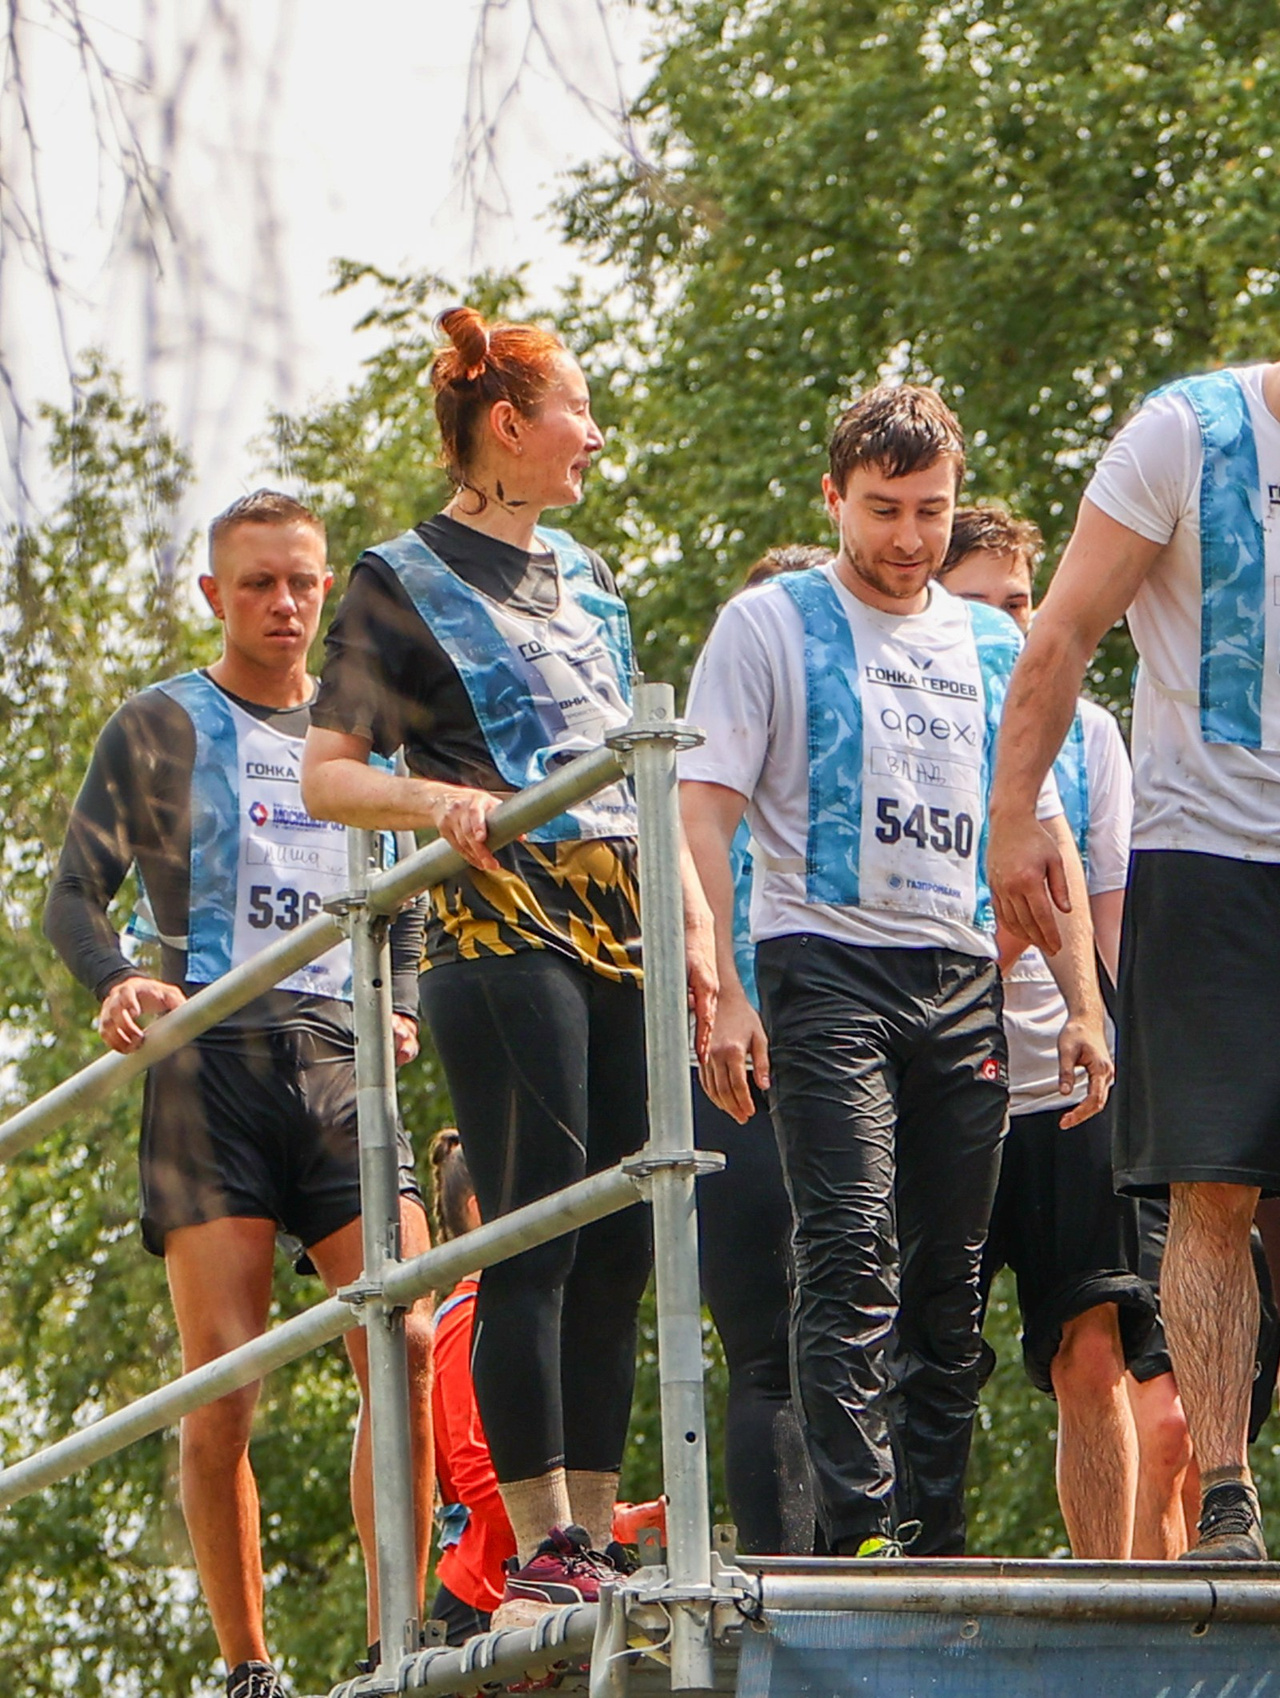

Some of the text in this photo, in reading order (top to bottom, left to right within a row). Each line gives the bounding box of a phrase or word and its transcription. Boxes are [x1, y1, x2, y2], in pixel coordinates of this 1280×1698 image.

[865, 666, 978, 697] ГОНКА ГЕРОЕВ
[245, 762, 297, 779] ГОНКА
[875, 797, 975, 859] 5450
